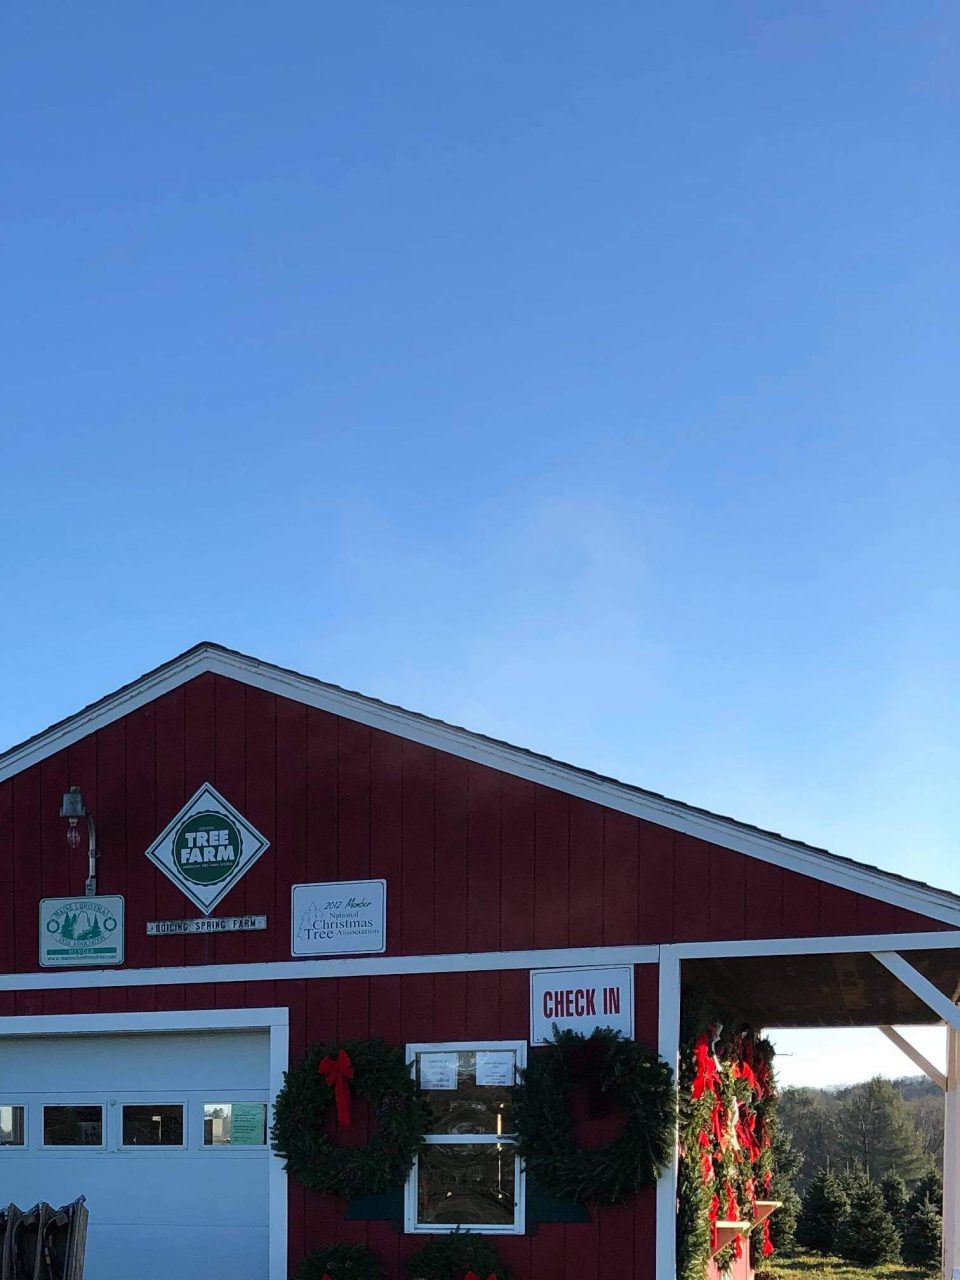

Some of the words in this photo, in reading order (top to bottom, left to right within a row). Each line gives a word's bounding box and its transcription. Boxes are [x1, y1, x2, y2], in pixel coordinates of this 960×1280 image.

[185, 830, 229, 848] TREE
[181, 845, 235, 864] FARM
[330, 911, 359, 919] National
[155, 922, 188, 932] BOILING
[195, 920, 226, 931] SPRING
[233, 919, 256, 929] FARM
[313, 920, 373, 930] Christmas
[304, 928, 334, 940] Tree
[543, 988, 596, 1019] CHECK
[603, 987, 620, 1015] IN
